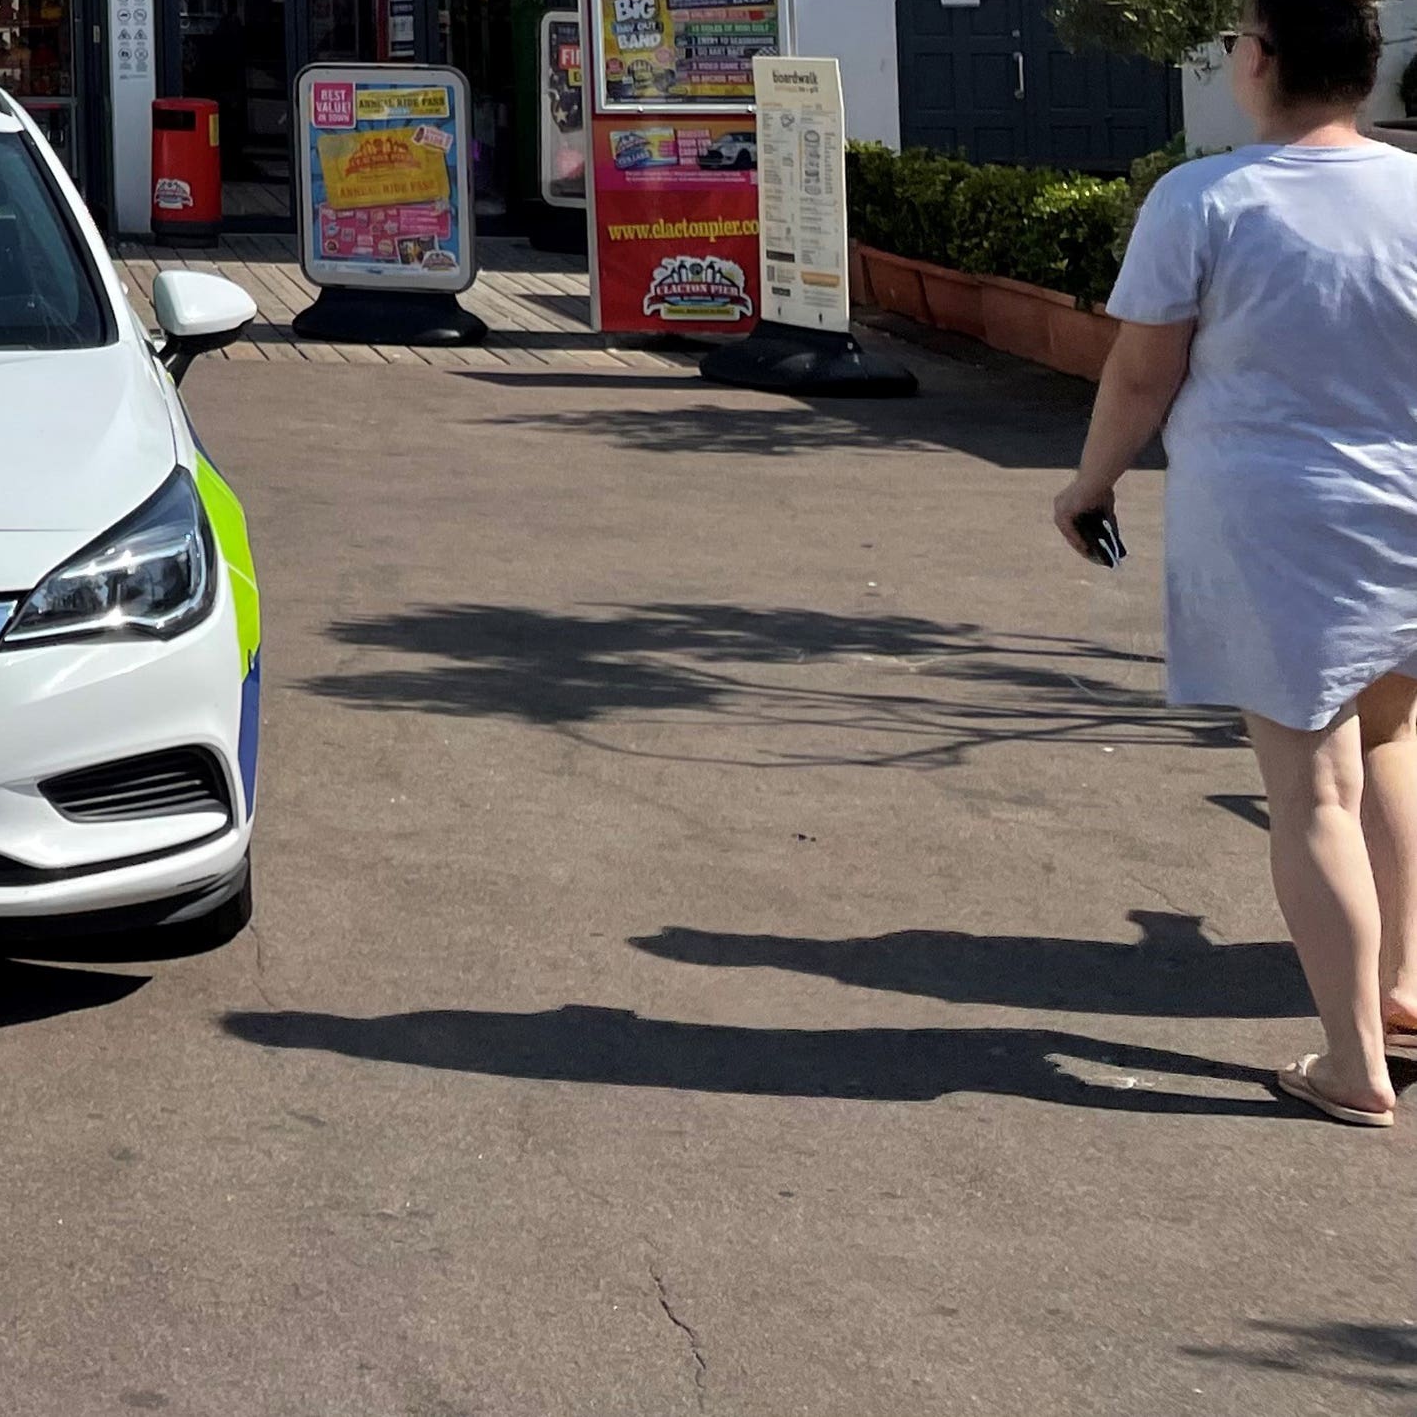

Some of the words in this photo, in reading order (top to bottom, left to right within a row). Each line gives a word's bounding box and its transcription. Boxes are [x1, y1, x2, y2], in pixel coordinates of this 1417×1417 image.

[617, 33, 662, 49] BAND
[772, 70, 819, 86] boardwalk
[320, 89, 347, 101] BEST
[315, 100, 352, 114] VALUE!
[656, 283, 708, 294] CLACTON
